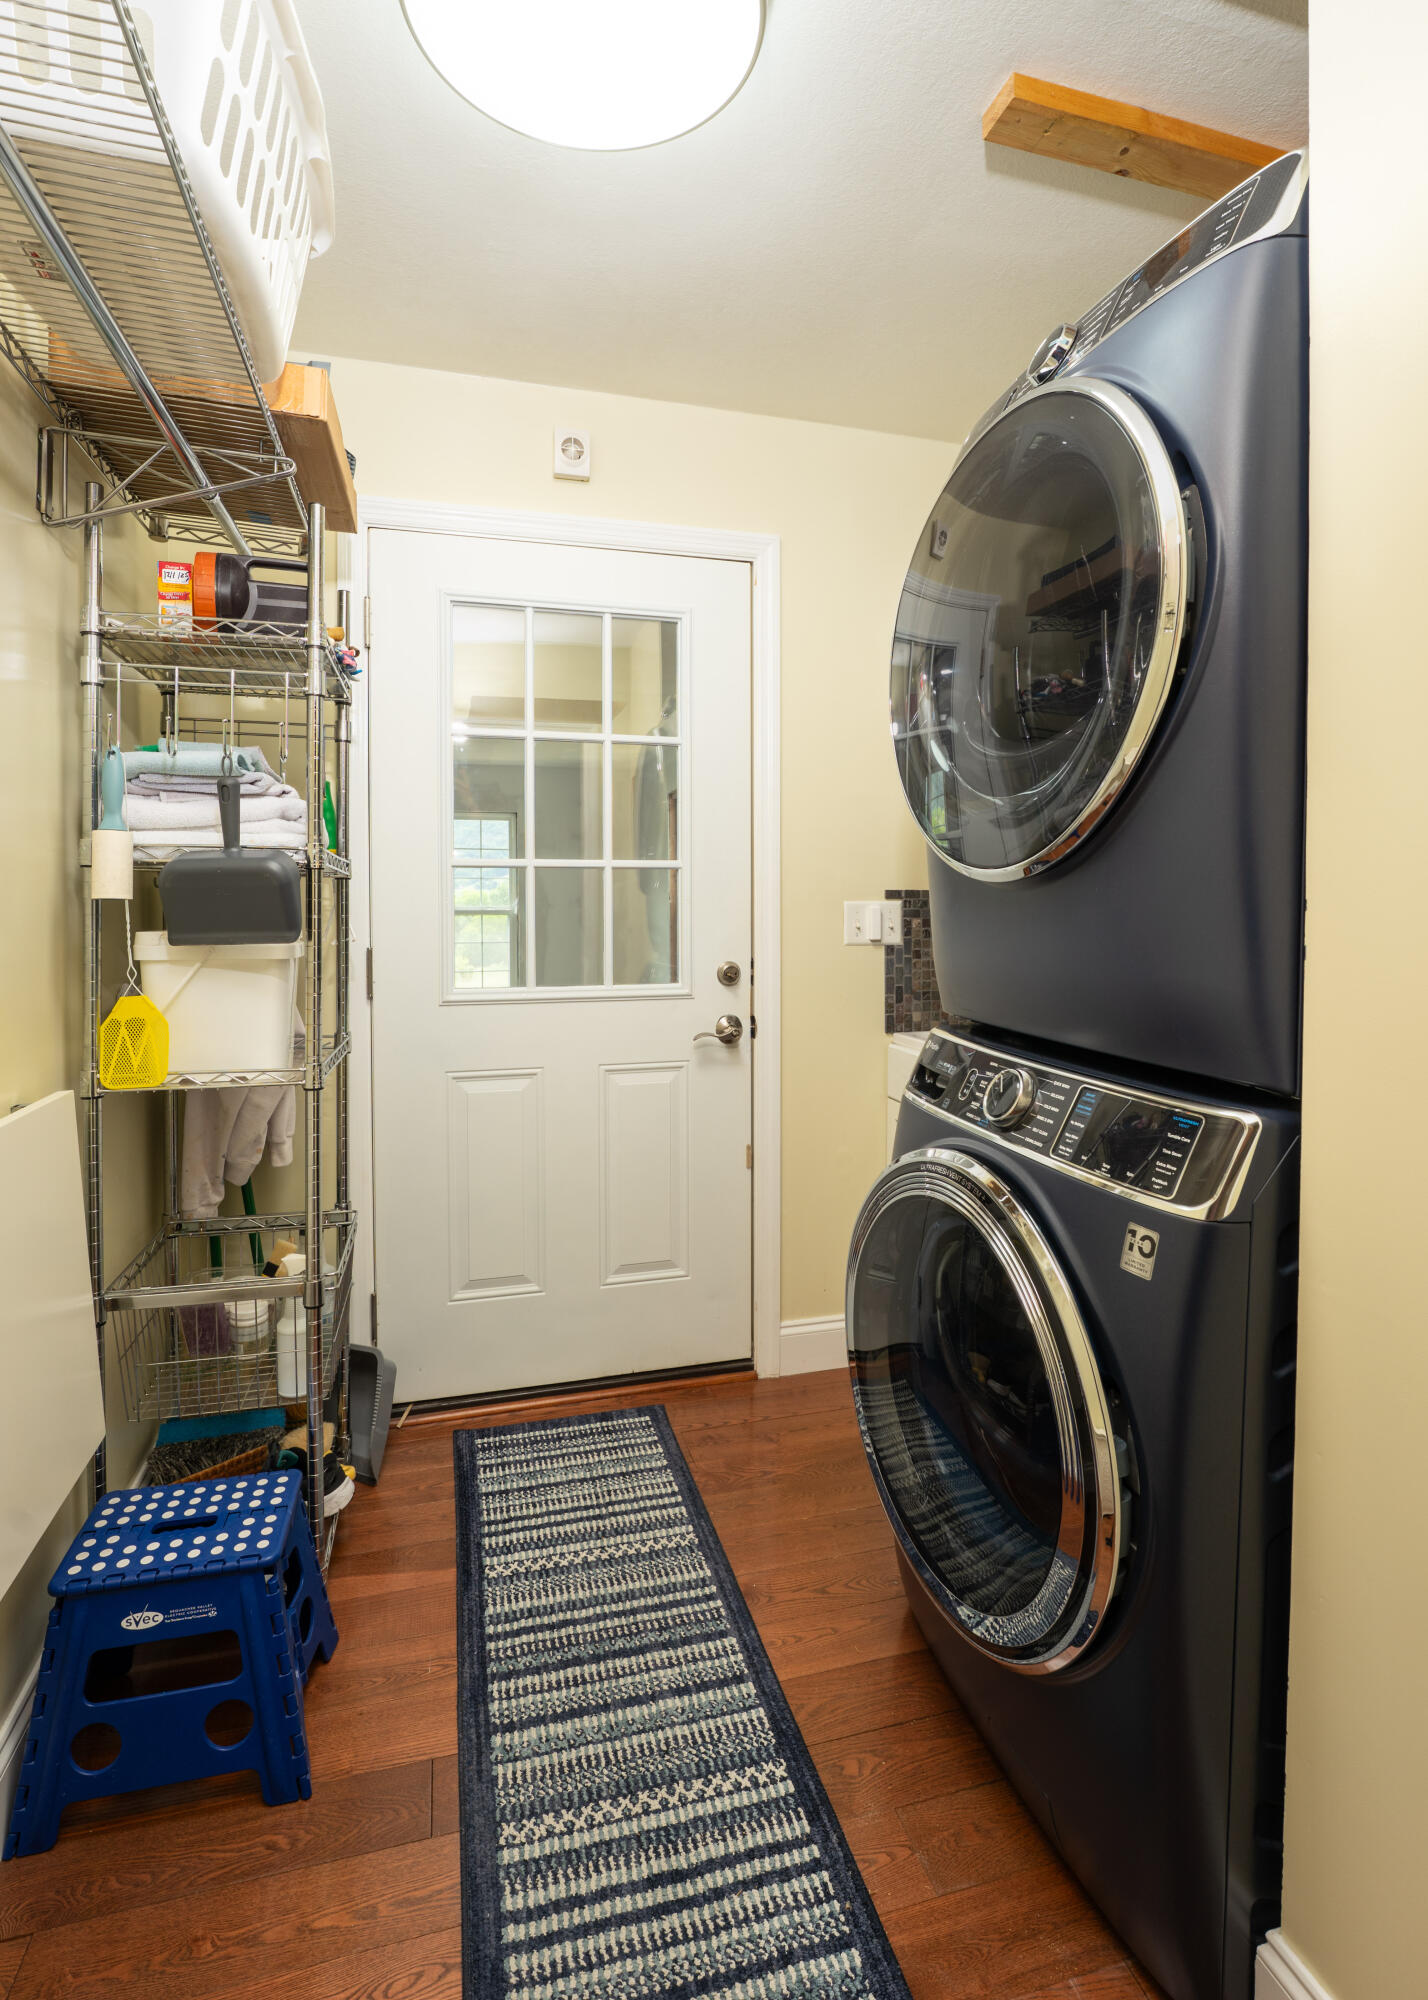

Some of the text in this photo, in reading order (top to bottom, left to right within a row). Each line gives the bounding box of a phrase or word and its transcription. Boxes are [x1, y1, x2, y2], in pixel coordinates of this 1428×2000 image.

[920, 1163, 950, 1176] ULTRAFRESH
[949, 1171, 963, 1182] VENT
[961, 1178, 982, 1198] SYSTEM
[1127, 1228, 1157, 1259] 10
